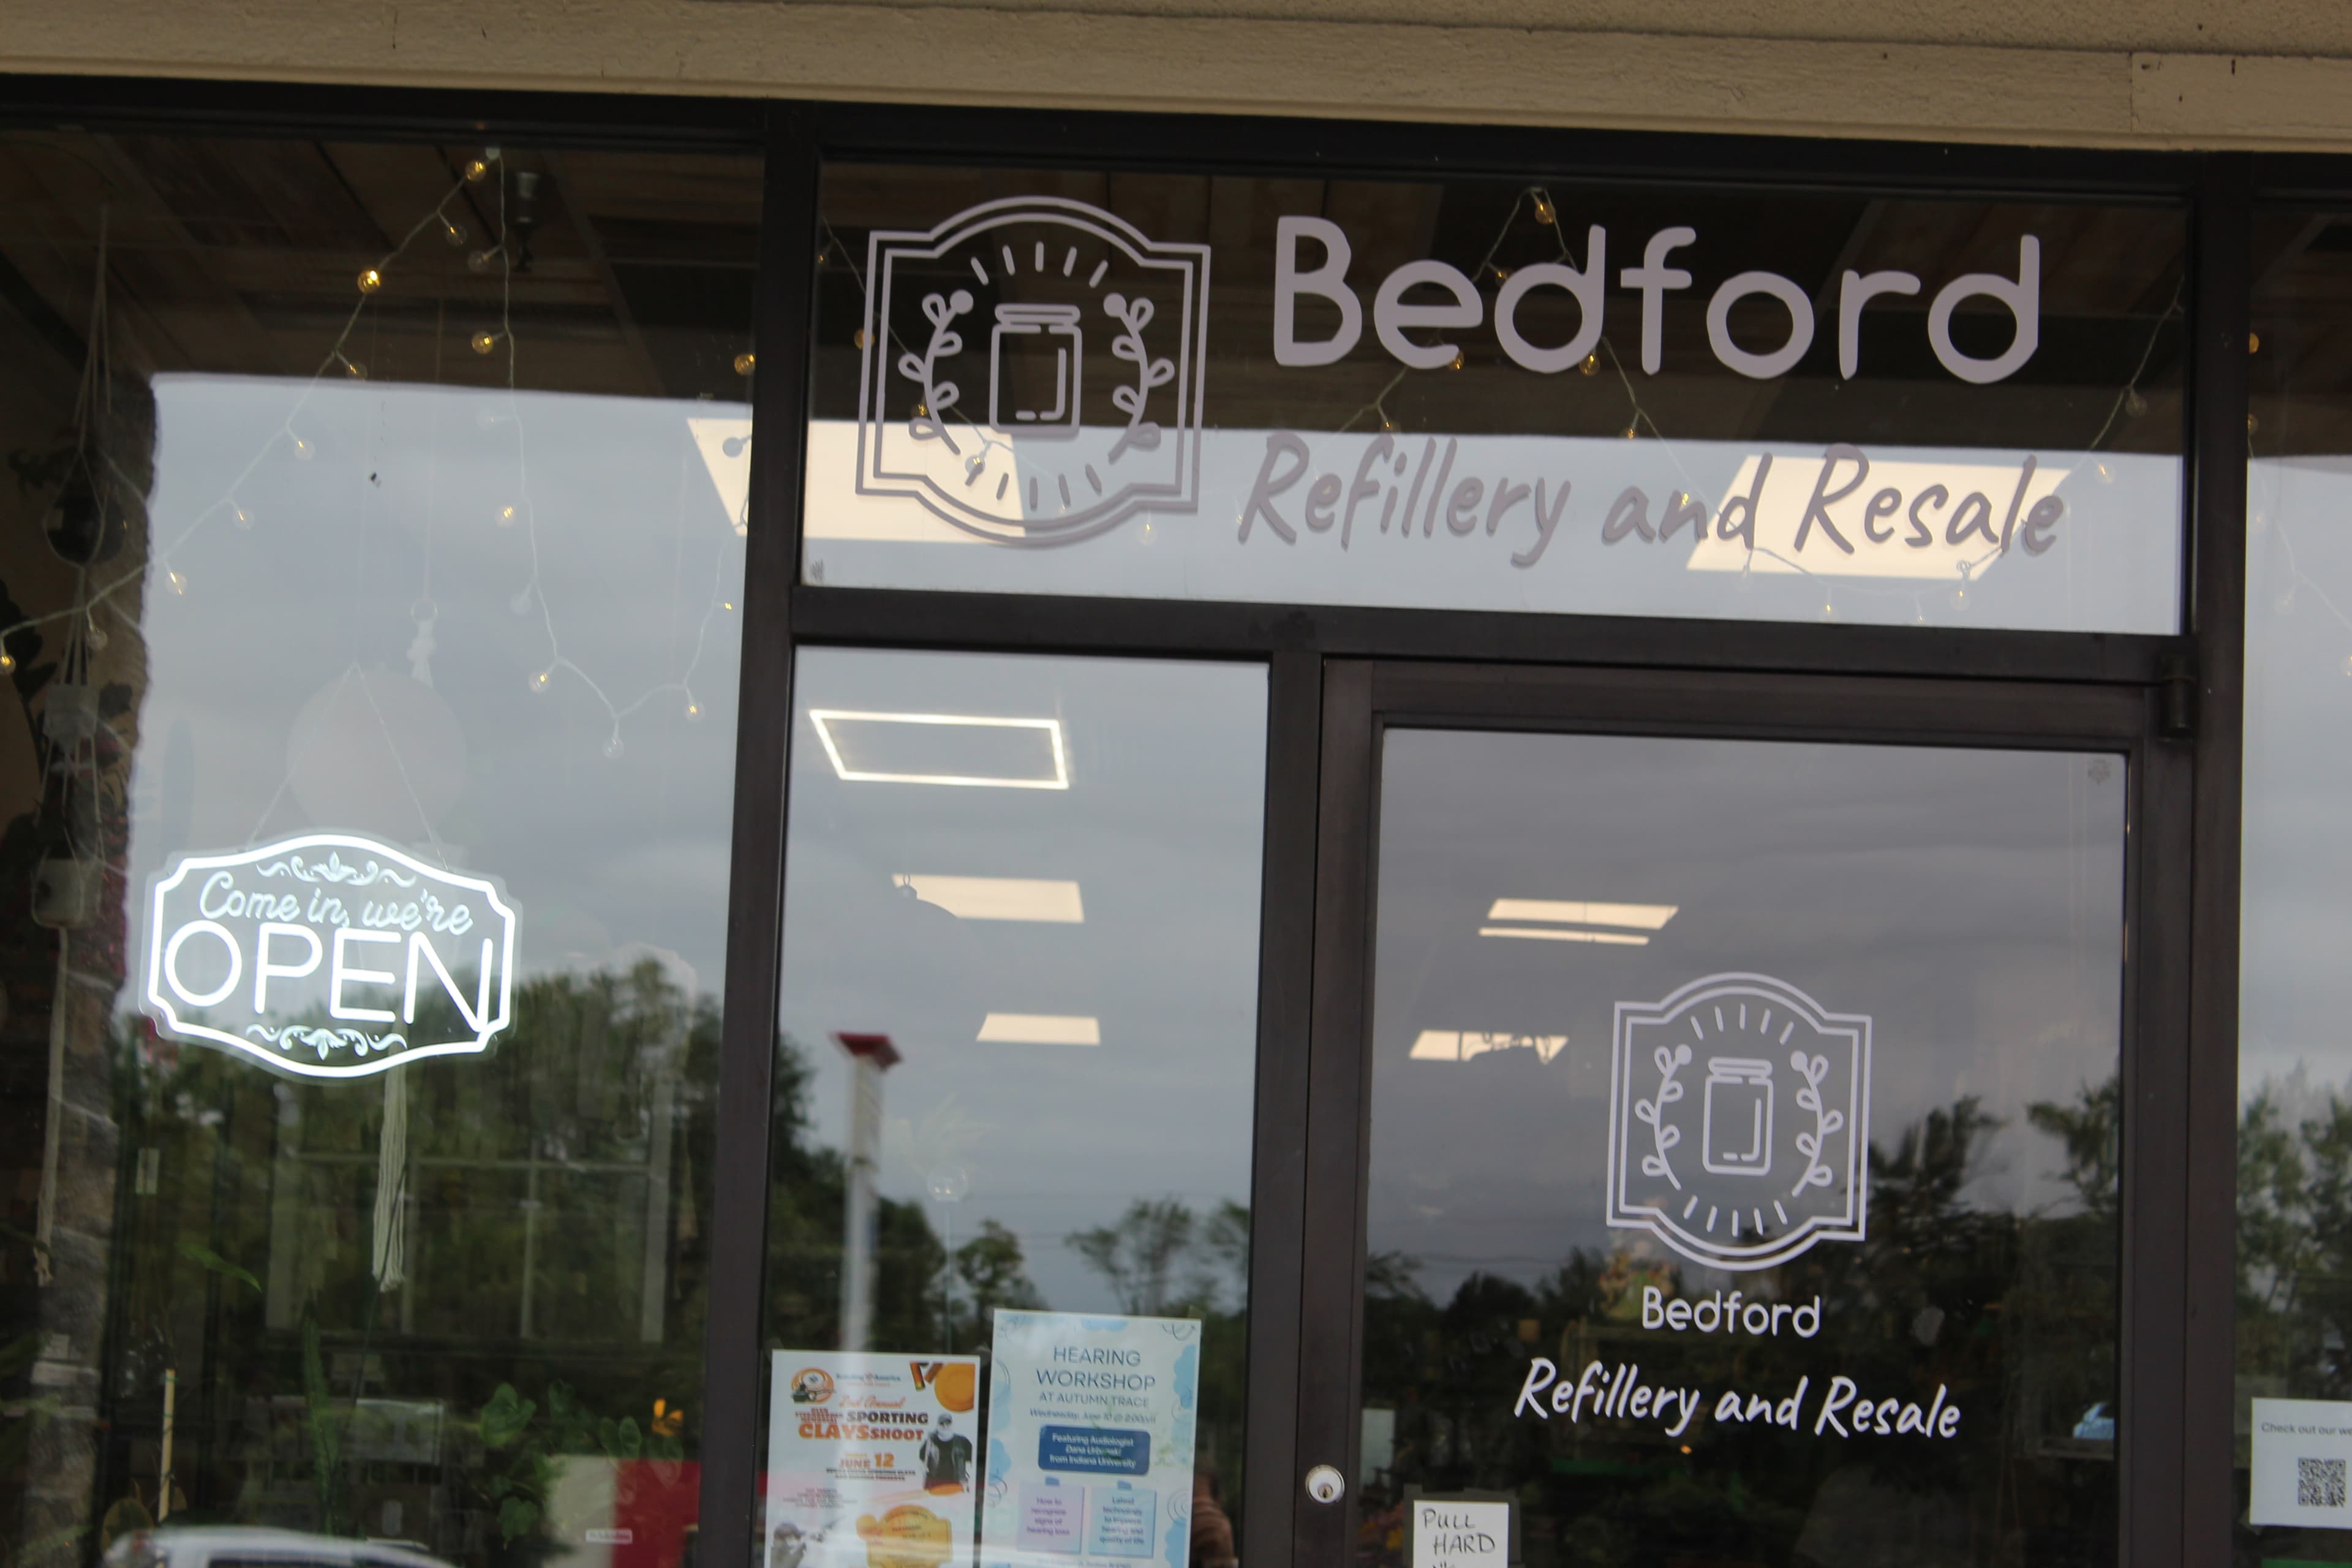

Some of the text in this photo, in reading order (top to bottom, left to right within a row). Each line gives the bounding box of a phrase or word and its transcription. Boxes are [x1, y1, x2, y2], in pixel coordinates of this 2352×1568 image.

[1273, 214, 2041, 384] Bedford
[1237, 431, 2066, 567] Refillery and Resale
[199, 870, 301, 920] Come
[362, 888, 473, 936] we're
[164, 919, 494, 1033] OPEN
[1642, 1286, 1820, 1338] Bedford
[1053, 1345, 1141, 1367] HEARING
[1036, 1367, 1156, 1392] WORKSHOP
[1039, 1392, 1149, 1408] AT AUTUMN TRACE
[1514, 1357, 1961, 1438] Refillery and Resale
[846, 1410, 929, 1425] SPORTING
[2261, 1421, 2295, 1434] Check
[2298, 1424, 2316, 1434] out
[2318, 1427, 2336, 1436] our
[798, 1422, 925, 1441] CLAYS SHOOT
[840, 1458, 871, 1469] JUNE
[875, 1451, 894, 1468] 12
[1422, 1507, 1476, 1529] PULL
[1432, 1532, 1496, 1556] HARD
